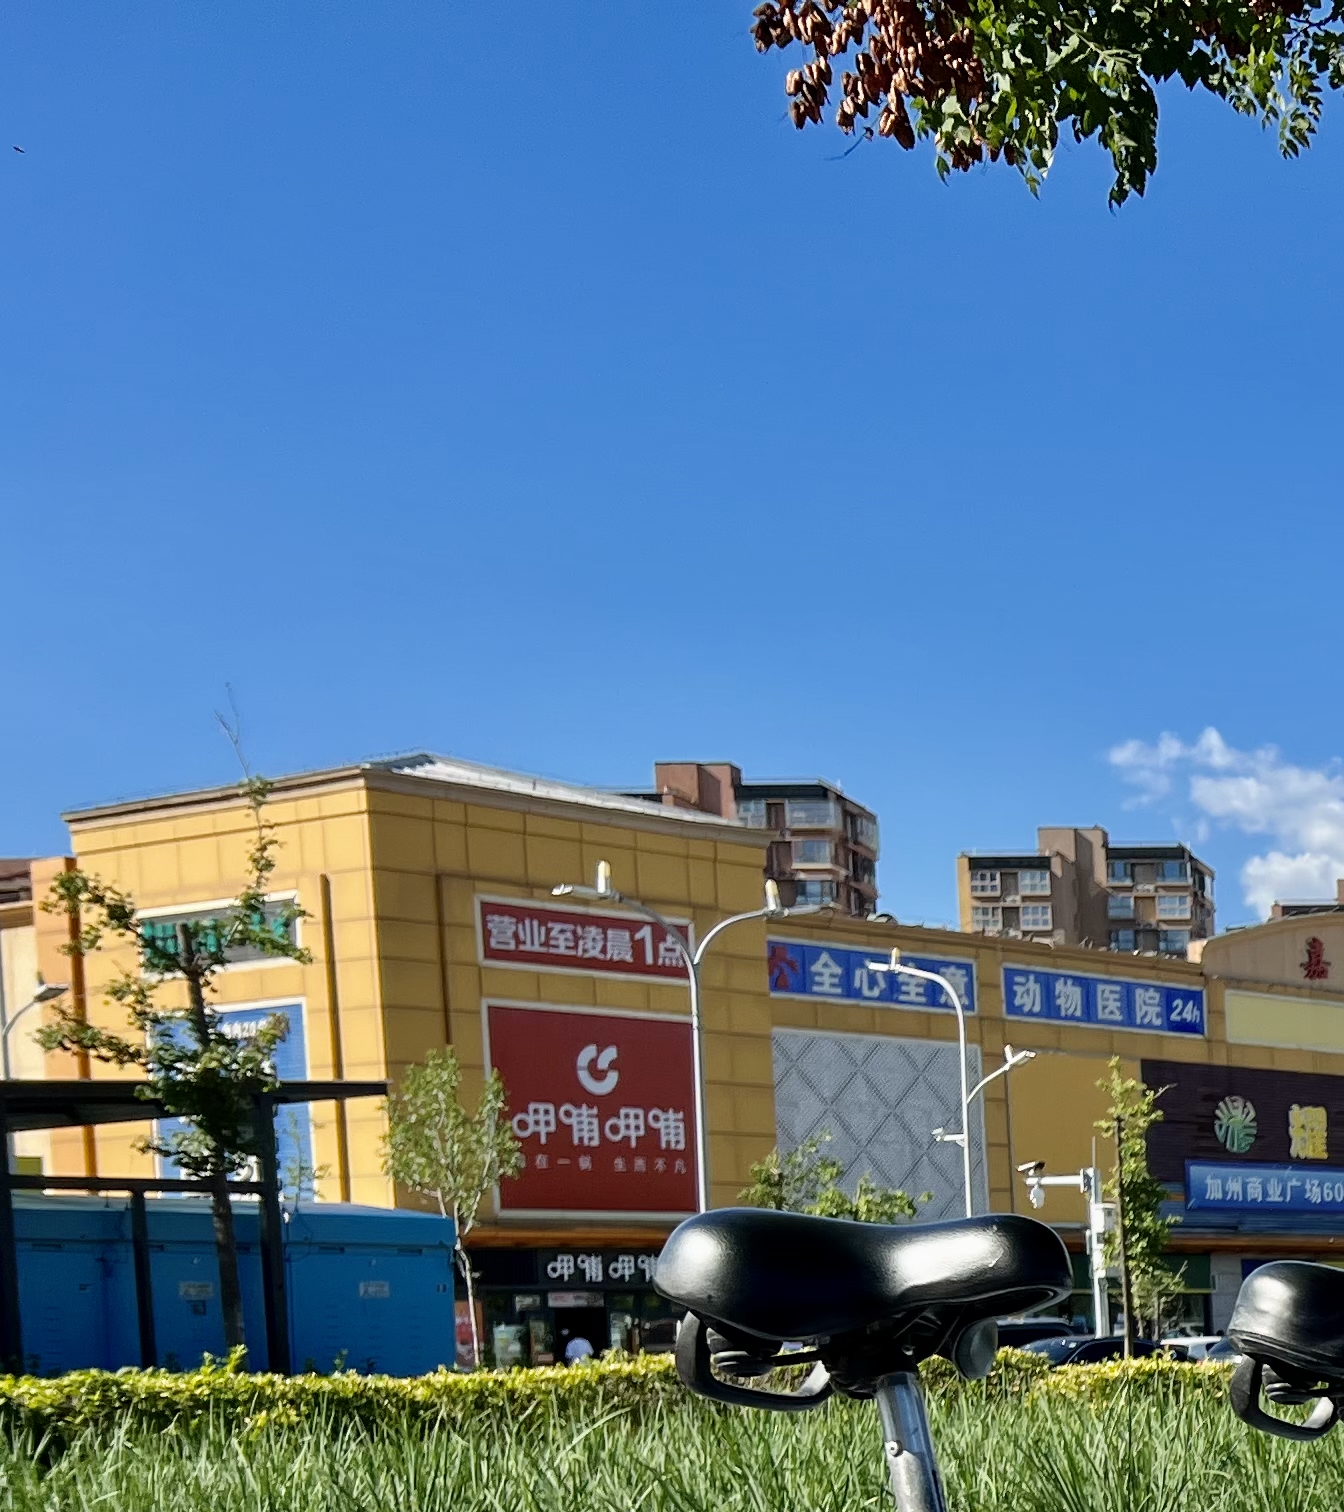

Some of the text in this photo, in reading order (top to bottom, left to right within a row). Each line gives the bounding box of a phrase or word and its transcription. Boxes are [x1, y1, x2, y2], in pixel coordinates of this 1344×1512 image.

[486, 914, 686, 968] 营业至凌晨1点
[1013, 973, 1162, 1026] 动物医院
[512, 1101, 685, 1150] 呷哺呷哺
